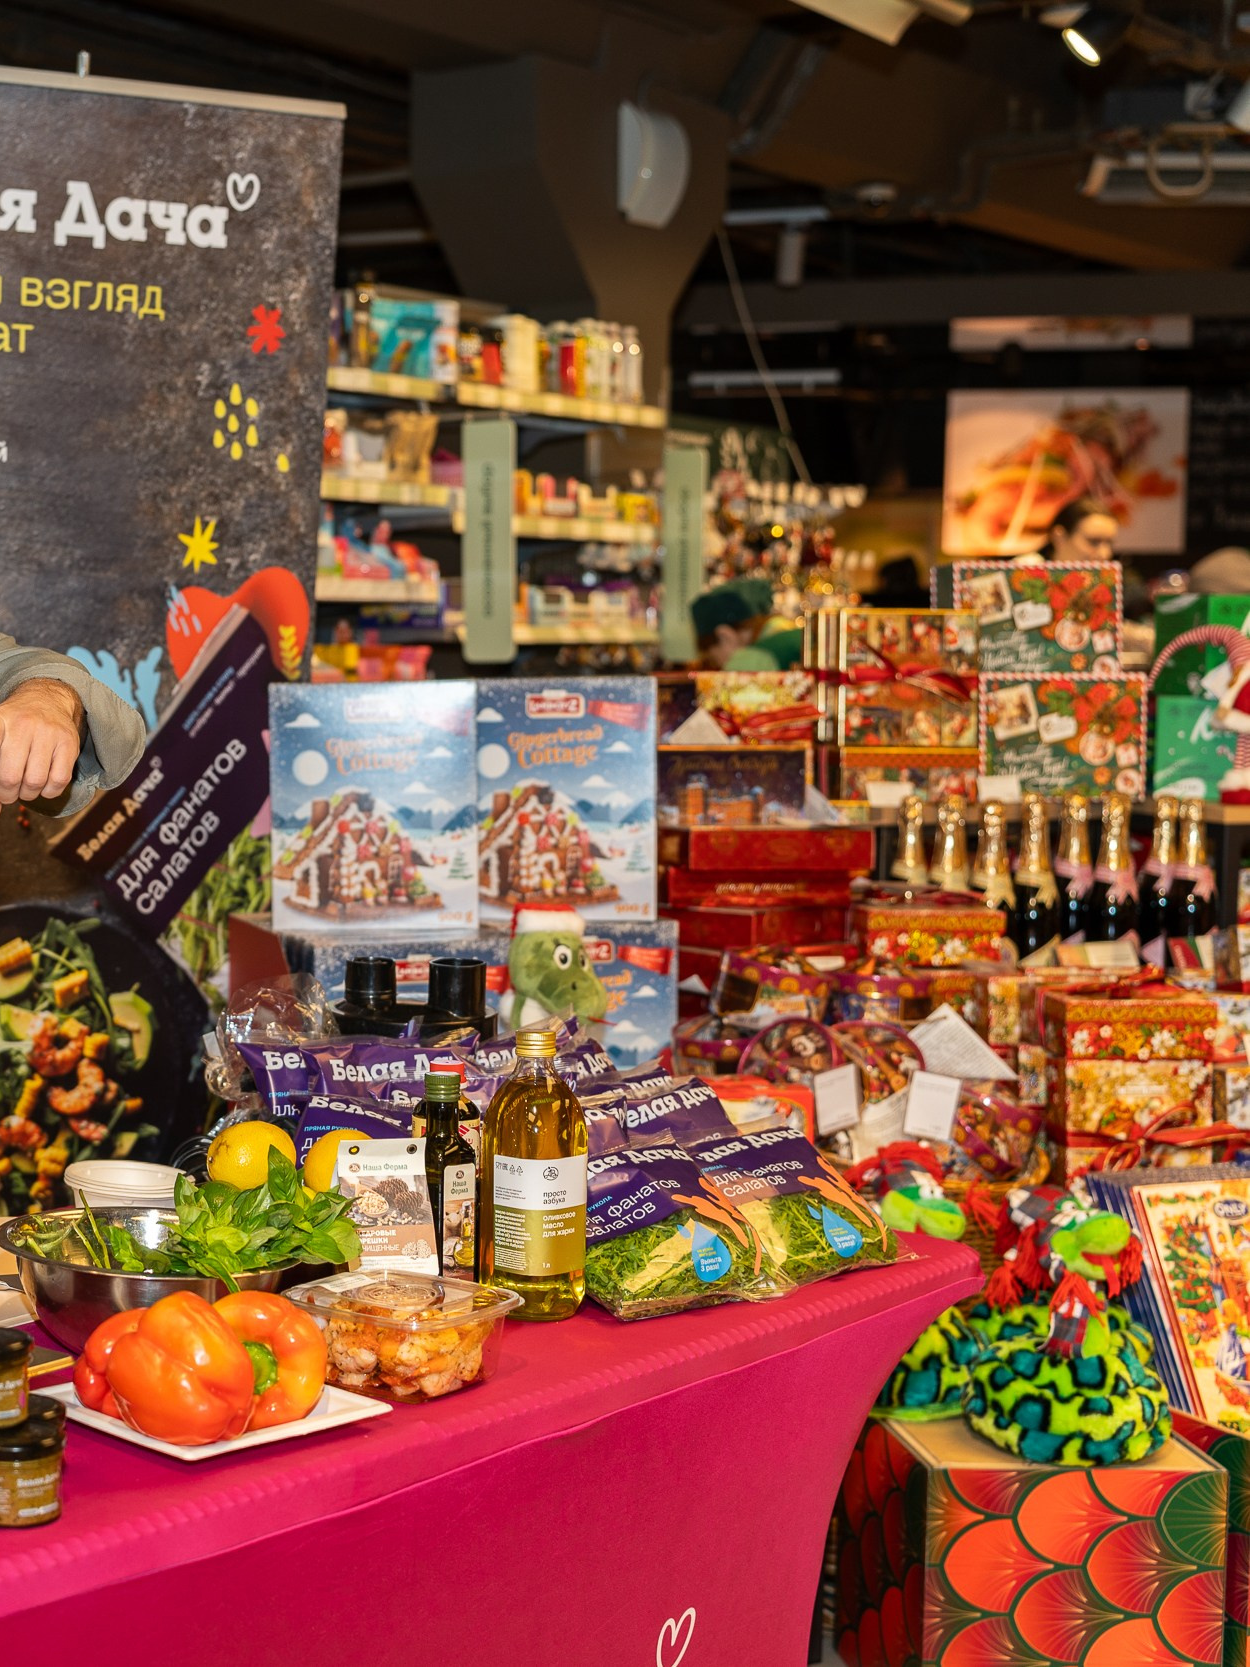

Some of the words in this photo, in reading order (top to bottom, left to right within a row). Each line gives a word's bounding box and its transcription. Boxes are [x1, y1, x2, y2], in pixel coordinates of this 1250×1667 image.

[54, 181, 229, 249] Дача
[20, 276, 165, 321] взгляд
[507, 723, 604, 749] Gingerbread
[336, 751, 419, 776] Cottage
[517, 744, 598, 769] Cottage
[76, 811, 127, 862] Белая
[122, 768, 164, 817] Дача
[116, 844, 161, 901] для
[159, 738, 248, 845] фанатов
[135, 810, 221, 916] салатов
[329, 1059, 406, 1082] Белая
[308, 1095, 403, 1127] Белая
[626, 1095, 682, 1128] елая
[675, 1085, 718, 1110] Дач
[698, 1141, 749, 1163] лая
[362, 1163, 382, 1172] Наша
[383, 1162, 409, 1172] Ферма
[452, 1180, 467, 1188] Наша
[713, 1170, 742, 1188] для
[723, 1175, 787, 1198] салатов
[450, 1187, 469, 1195] Ферма
[543, 1189, 567, 1199] просто
[543, 1197, 566, 1205] азбука
[607, 1179, 681, 1218] фанатов
[587, 1195, 613, 1213] РУКОЛА
[542, 1211, 576, 1222] оливковое
[543, 1221, 564, 1230] масло
[585, 1202, 657, 1238] салатов
[556, 1228, 575, 1237] жарки
[362, 1243, 401, 1253] ЧИЩЕННЫЕ
[700, 1256, 723, 1266] Вымыта
[700, 1264, 705, 1272] 3
